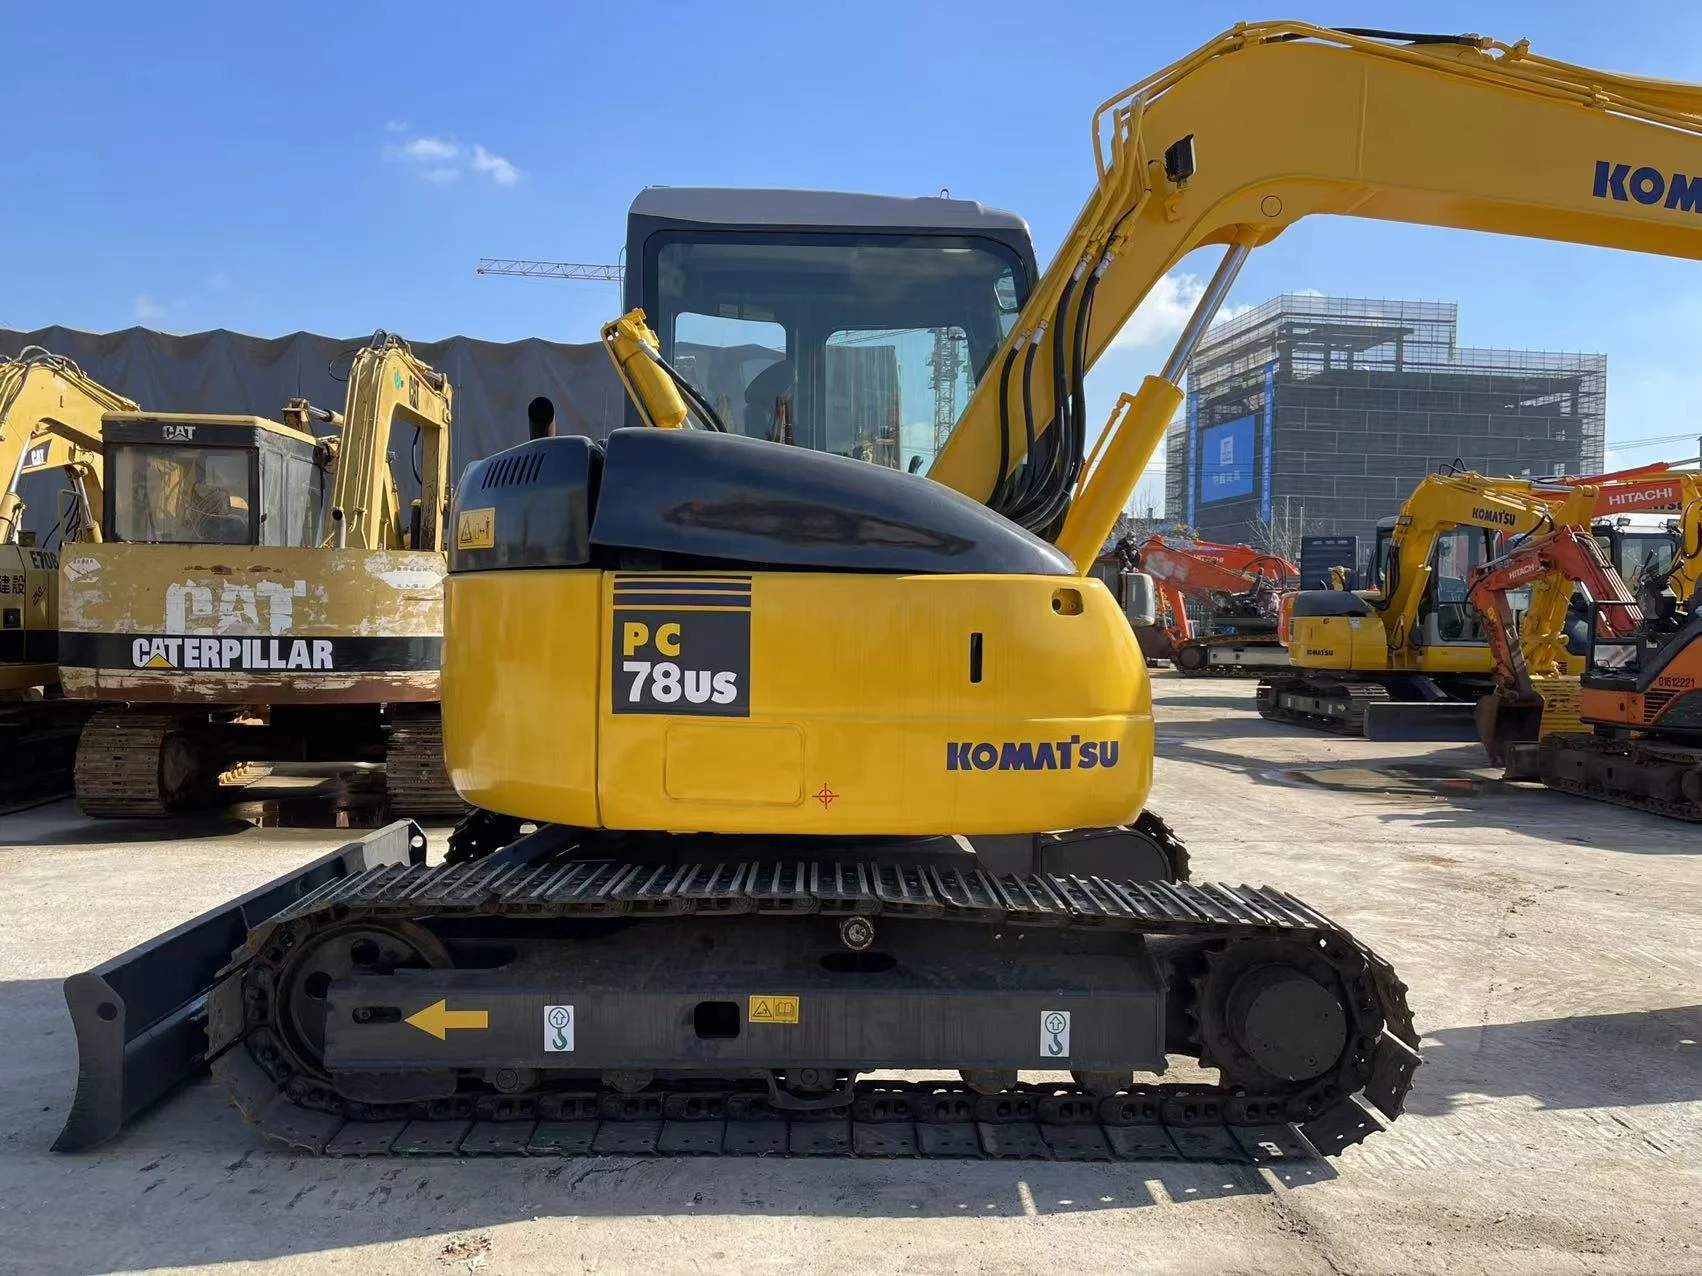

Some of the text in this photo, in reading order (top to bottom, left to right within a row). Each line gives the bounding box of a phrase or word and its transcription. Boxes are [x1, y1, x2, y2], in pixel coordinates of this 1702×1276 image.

[162, 425, 196, 441] CAT
[31, 449, 44, 466] CAT
[1608, 487, 1672, 506] HITACHI
[1472, 507, 1516, 526] KOMATSU
[30, 551, 58, 569] E70B
[165, 579, 307, 637] CAT
[622, 621, 681, 657] PC
[132, 637, 334, 670] CATERPILLAR
[946, 734, 1119, 771] KOMATSU
